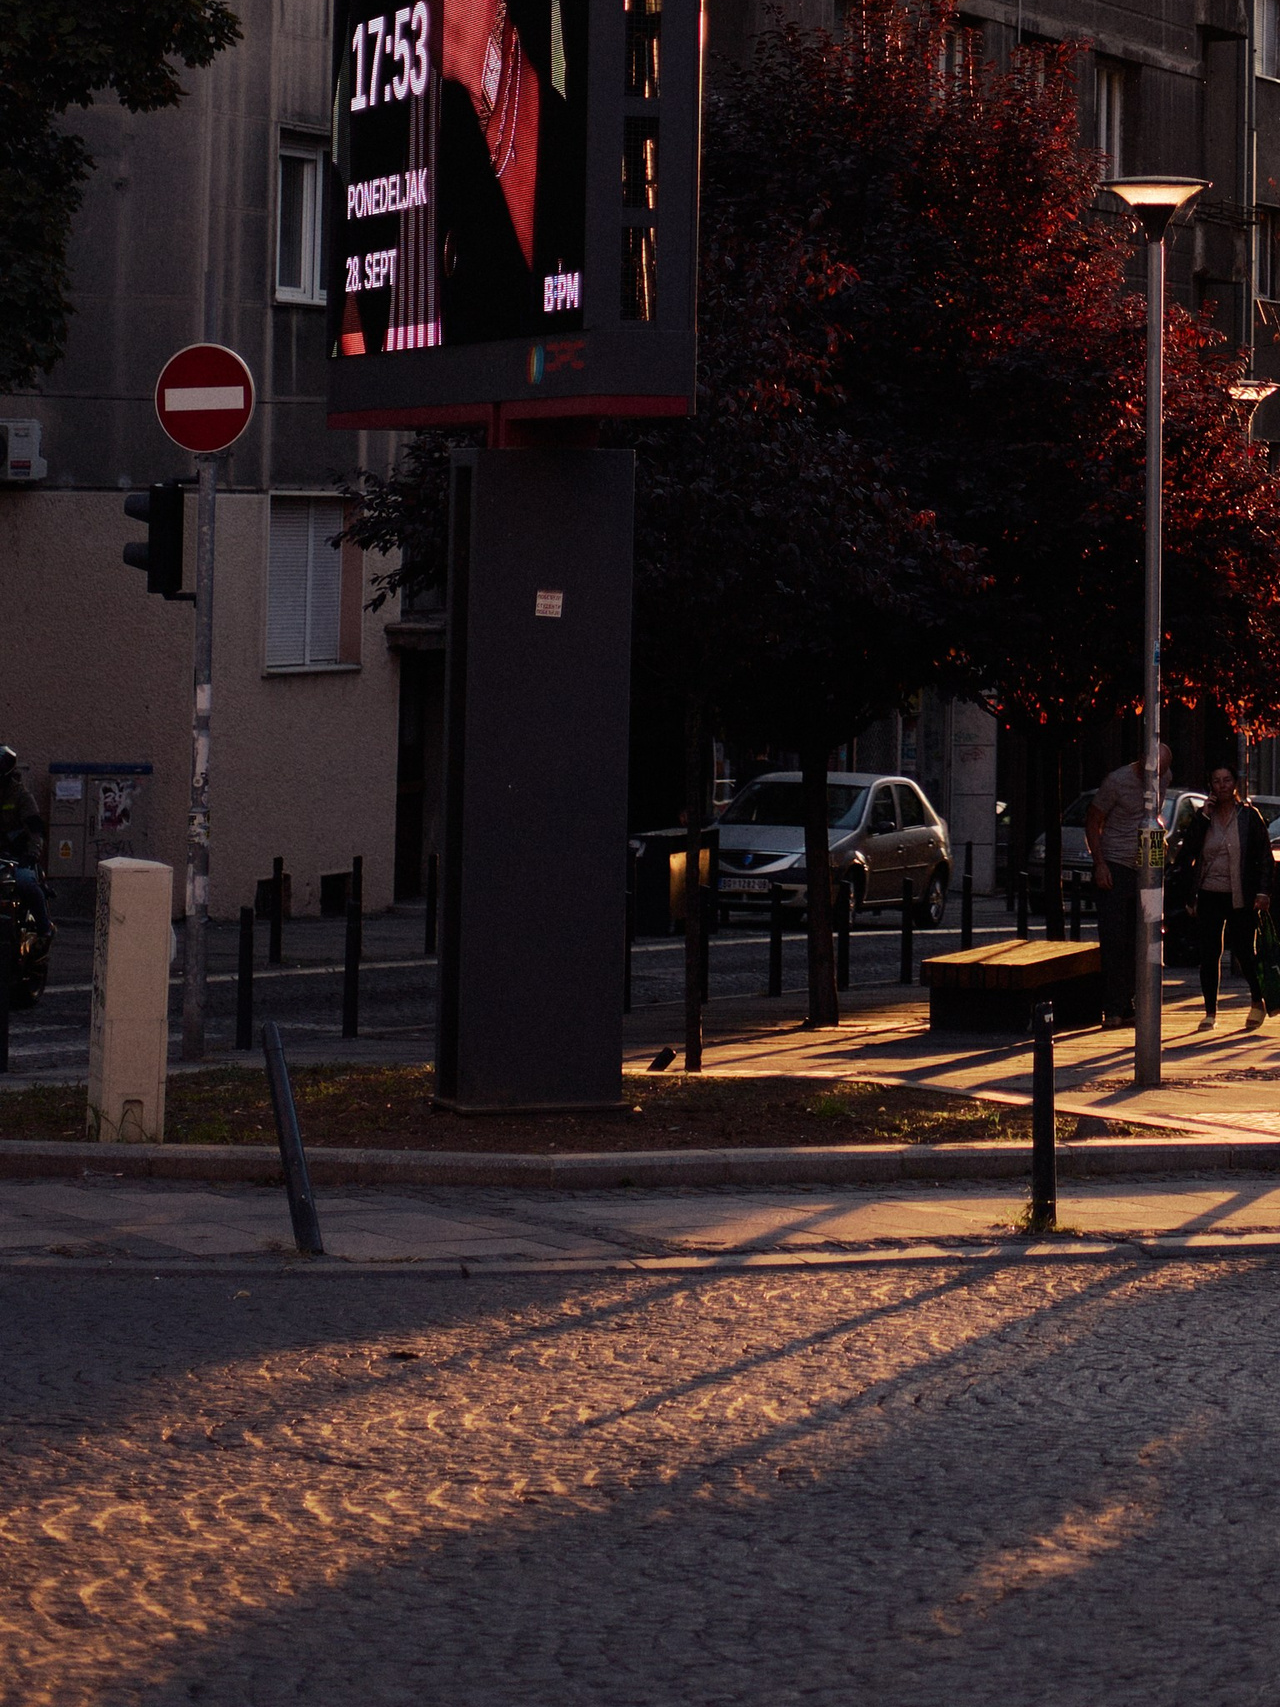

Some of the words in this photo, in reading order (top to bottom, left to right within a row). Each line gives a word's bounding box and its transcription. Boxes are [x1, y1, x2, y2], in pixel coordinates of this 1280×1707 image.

[351, 1, 428, 112] 17:53
[347, 167, 428, 220] PONEDELJAK
[345, 255, 362, 292] 28.
[364, 249, 397, 289] SEPT
